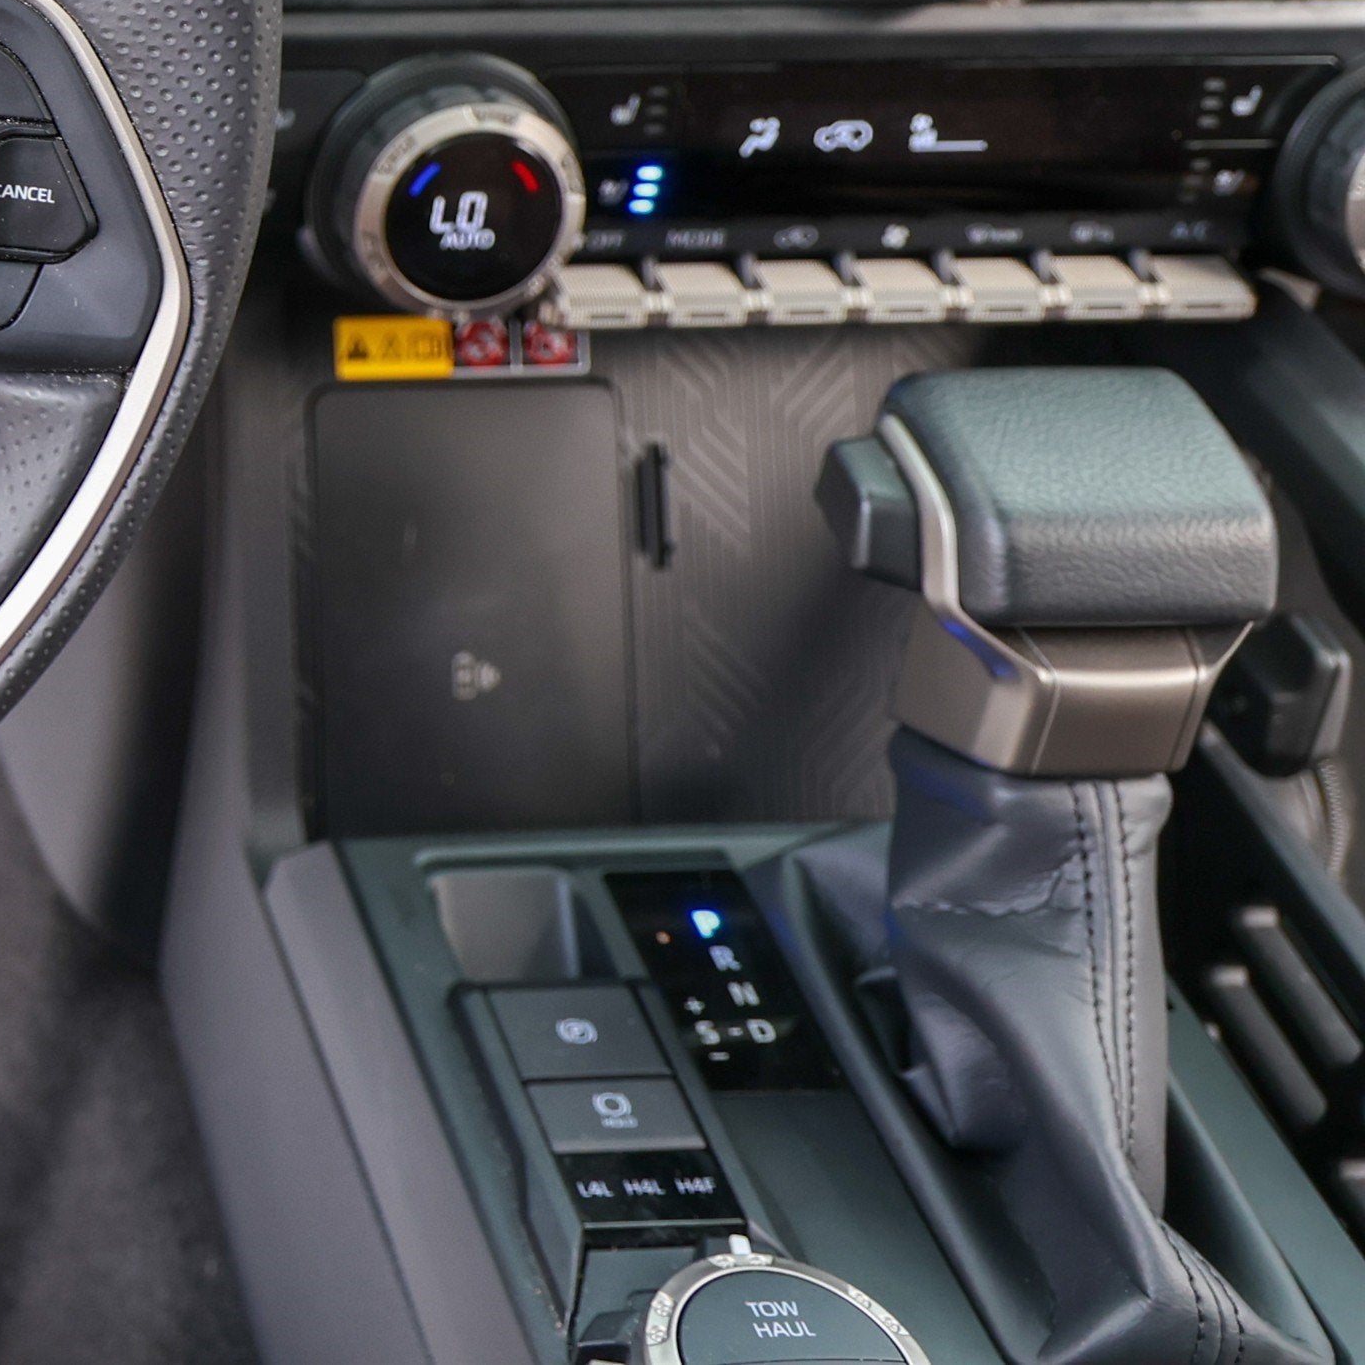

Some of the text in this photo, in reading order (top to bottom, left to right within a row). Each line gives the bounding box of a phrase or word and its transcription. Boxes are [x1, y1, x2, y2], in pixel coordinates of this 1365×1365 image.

[428, 190, 489, 235] LO
[691, 909, 722, 939] P
[708, 945, 743, 972] R
[746, 1018, 777, 1044] D
[744, 1300, 799, 1318] TOW
[753, 1321, 817, 1339] HAUL
